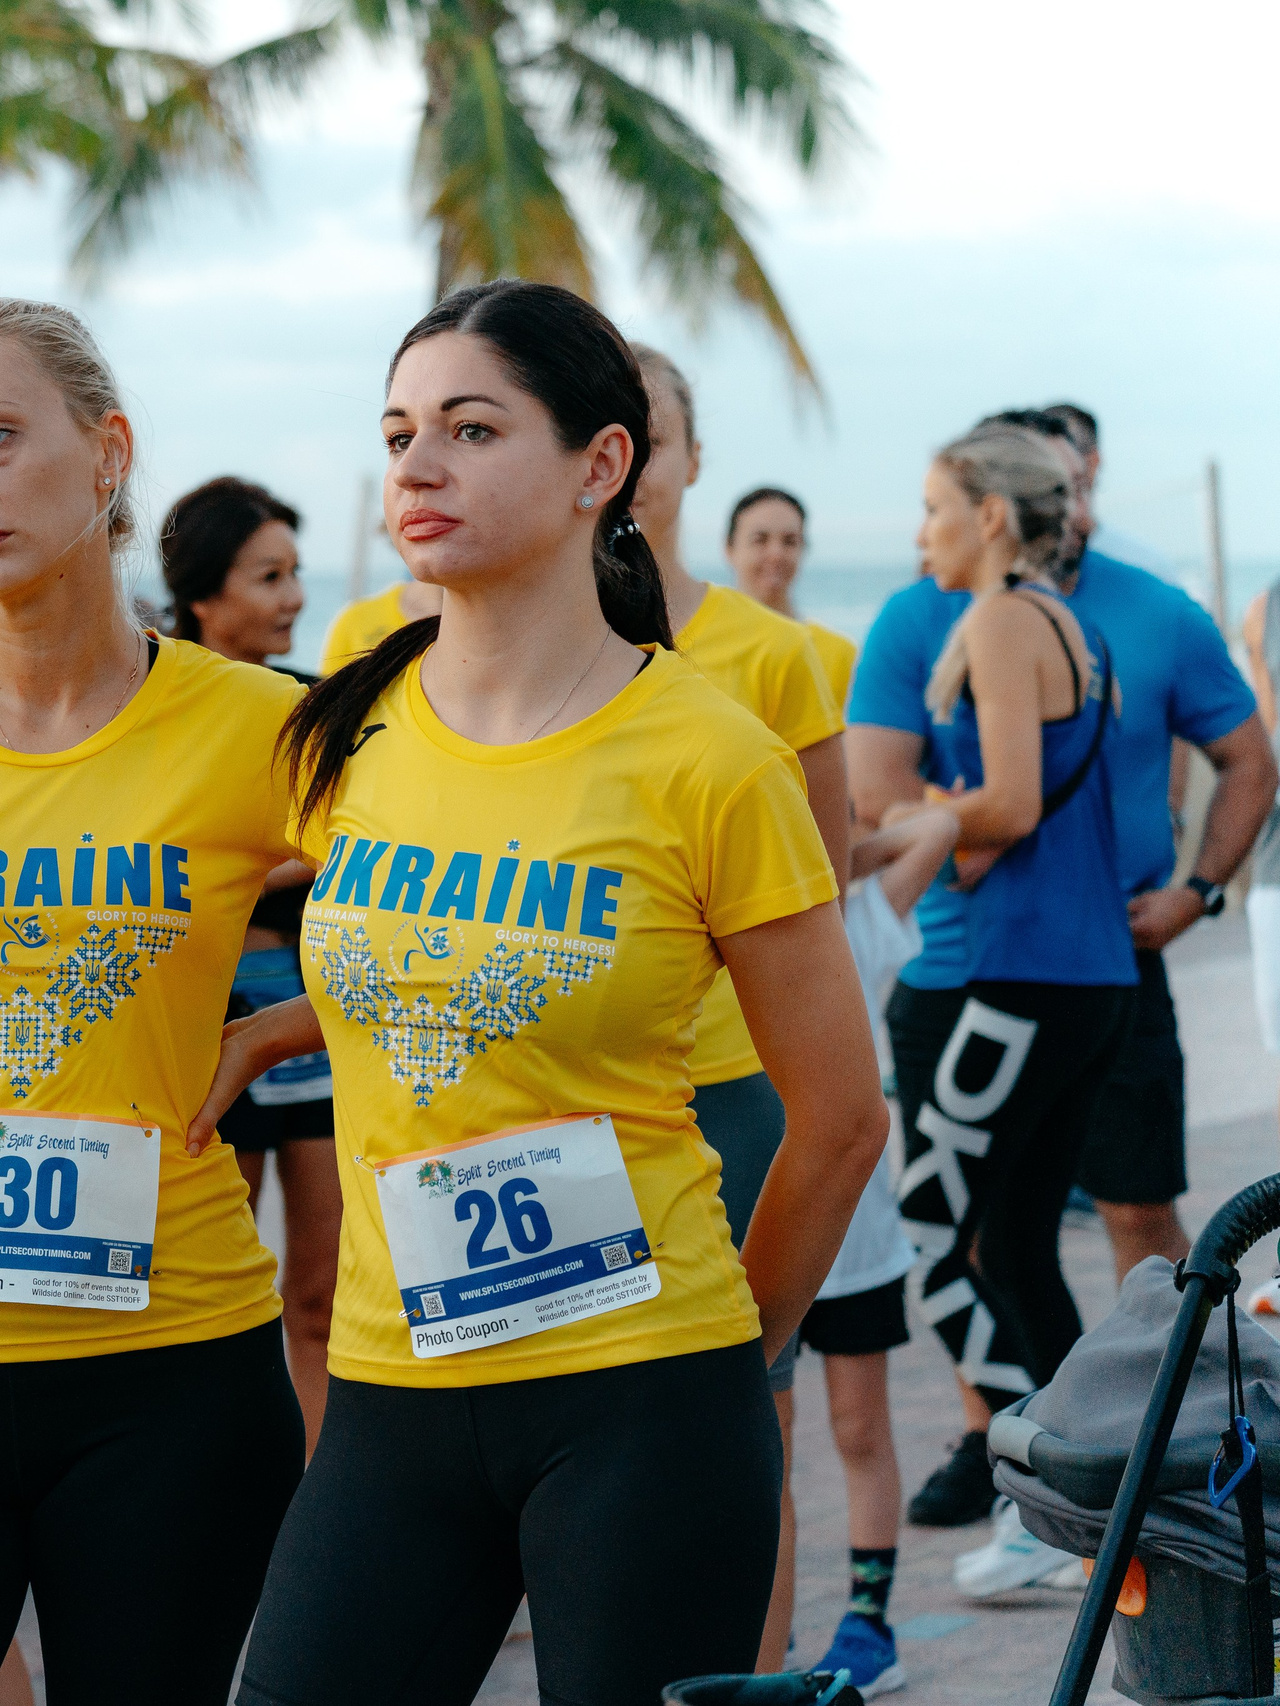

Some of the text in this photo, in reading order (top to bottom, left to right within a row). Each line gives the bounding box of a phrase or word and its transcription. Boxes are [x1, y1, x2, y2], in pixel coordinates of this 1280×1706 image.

[312, 835, 624, 941] UKRAINE
[87, 910, 192, 929] GLORY TO HEROES!
[324, 908, 368, 923] UKRAINI!
[495, 929, 616, 956] GLORY TO HEROES!
[7, 1133, 110, 1159] Split Second Timing
[457, 1147, 562, 1186] Split Second Timing
[454, 1177, 553, 1270] 26
[33, 1278, 139, 1295] Good for 10% off events shot by
[459, 1260, 584, 1301] WWW.SPLITSECONDTIMING.COM
[535, 1274, 647, 1313] Good for 10% off events shot by
[32, 1288, 62, 1298] Wildside
[64, 1290, 86, 1300] Online.
[88, 1293, 104, 1302] Code
[538, 1310, 569, 1323] Wildside
[570, 1303, 596, 1314] Online.
[596, 1296, 615, 1307] Code
[416, 1328, 454, 1349] Photo
[456, 1317, 509, 1340] Coupon
